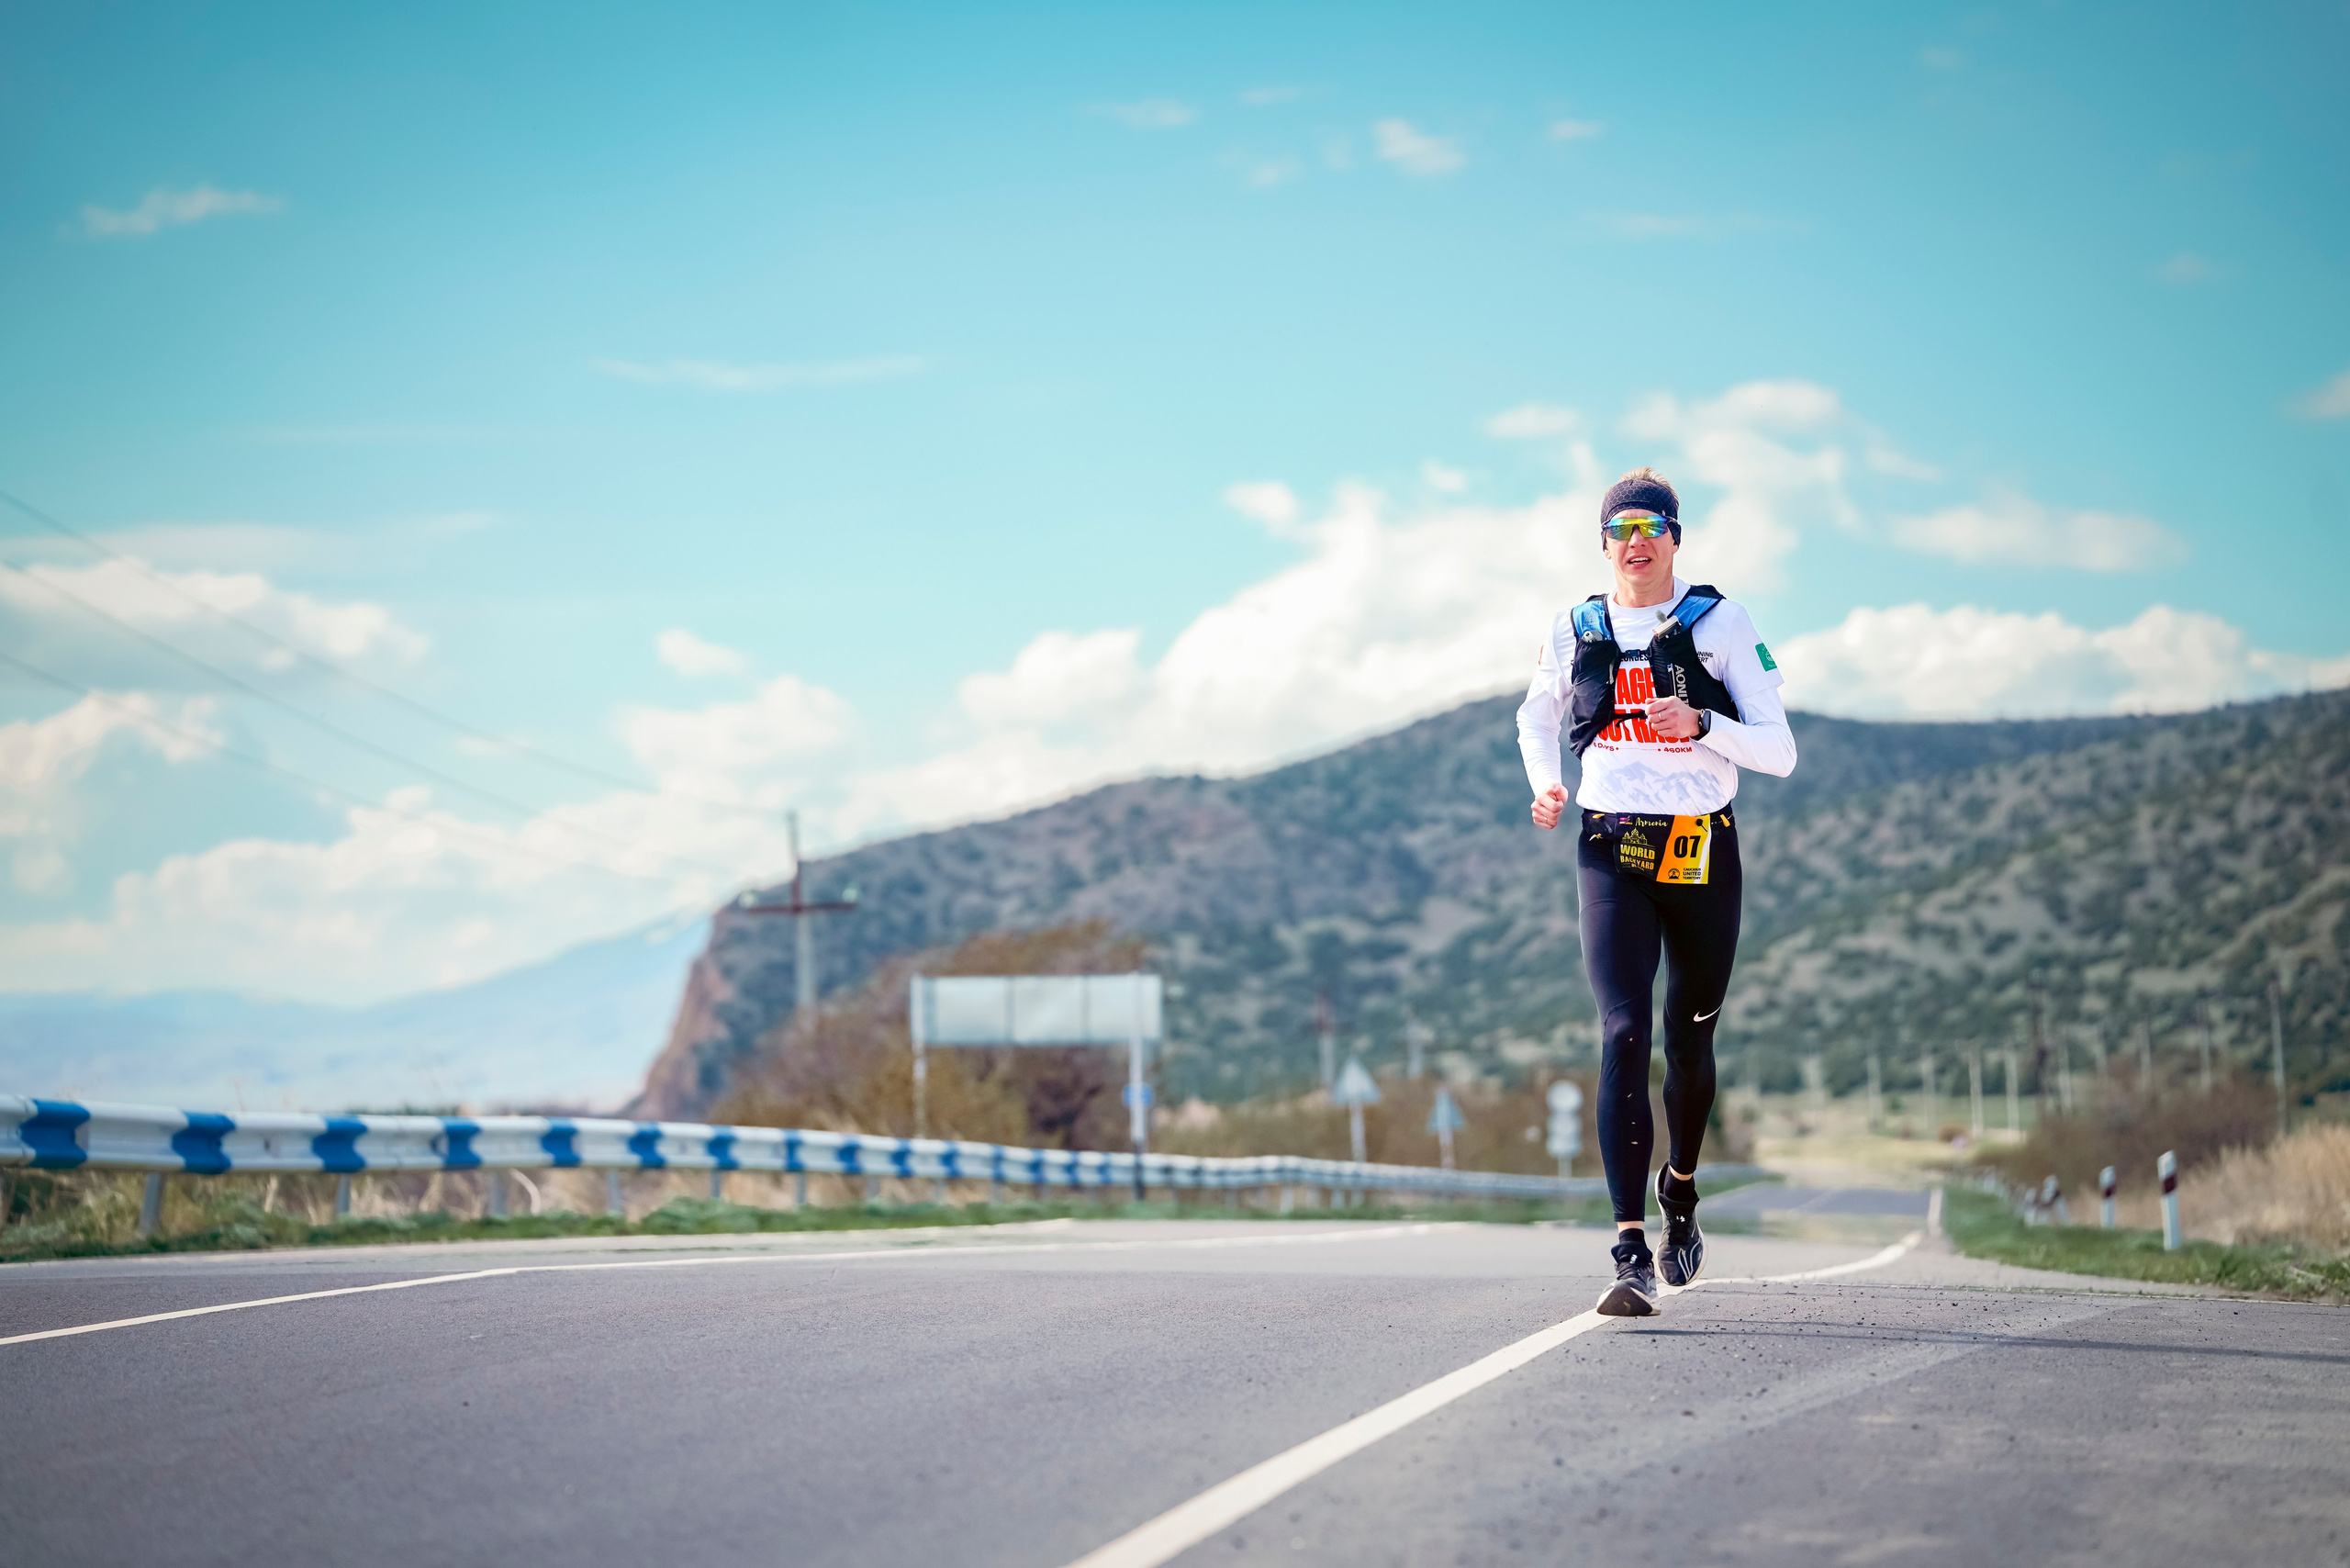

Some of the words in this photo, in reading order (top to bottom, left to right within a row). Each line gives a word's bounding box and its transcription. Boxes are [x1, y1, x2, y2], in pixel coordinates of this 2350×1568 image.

[1619, 844, 1656, 860] WORLD
[1673, 834, 1701, 858] 07
[1619, 855, 1655, 870] BACKYARD
